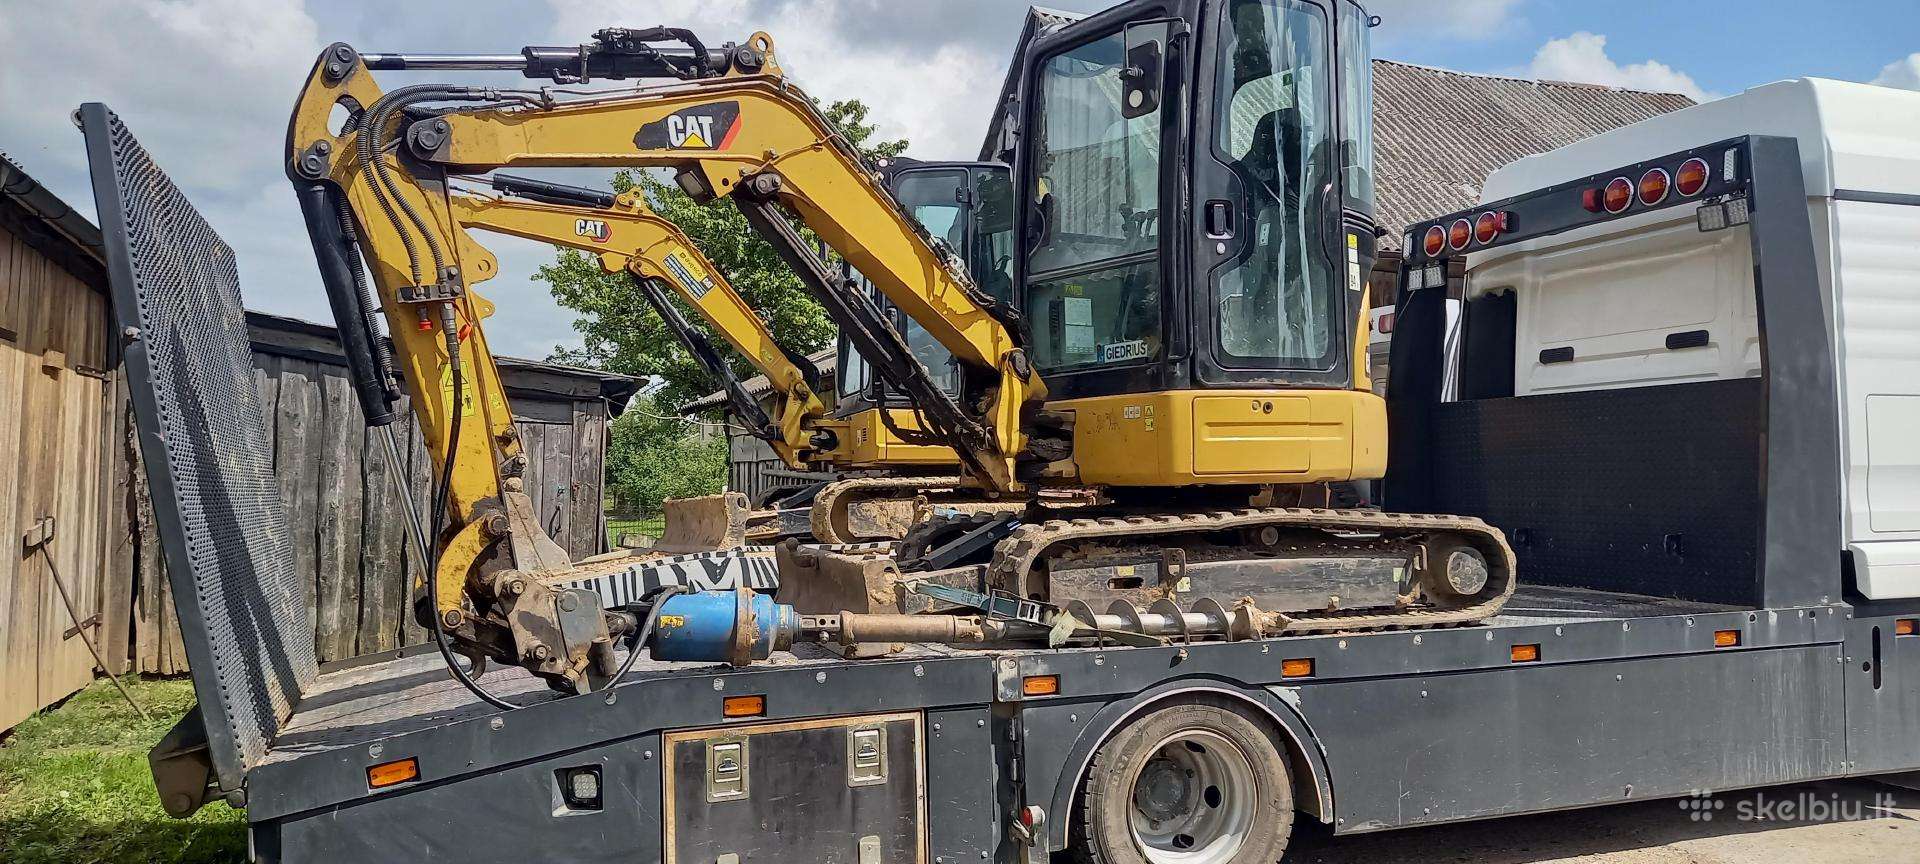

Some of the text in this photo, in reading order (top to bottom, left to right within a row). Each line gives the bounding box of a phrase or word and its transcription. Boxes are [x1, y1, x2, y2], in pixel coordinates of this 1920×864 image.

[668, 115, 713, 147] CAT
[575, 219, 604, 238] CAT
[1106, 342, 1148, 360] GIEDRIUS
